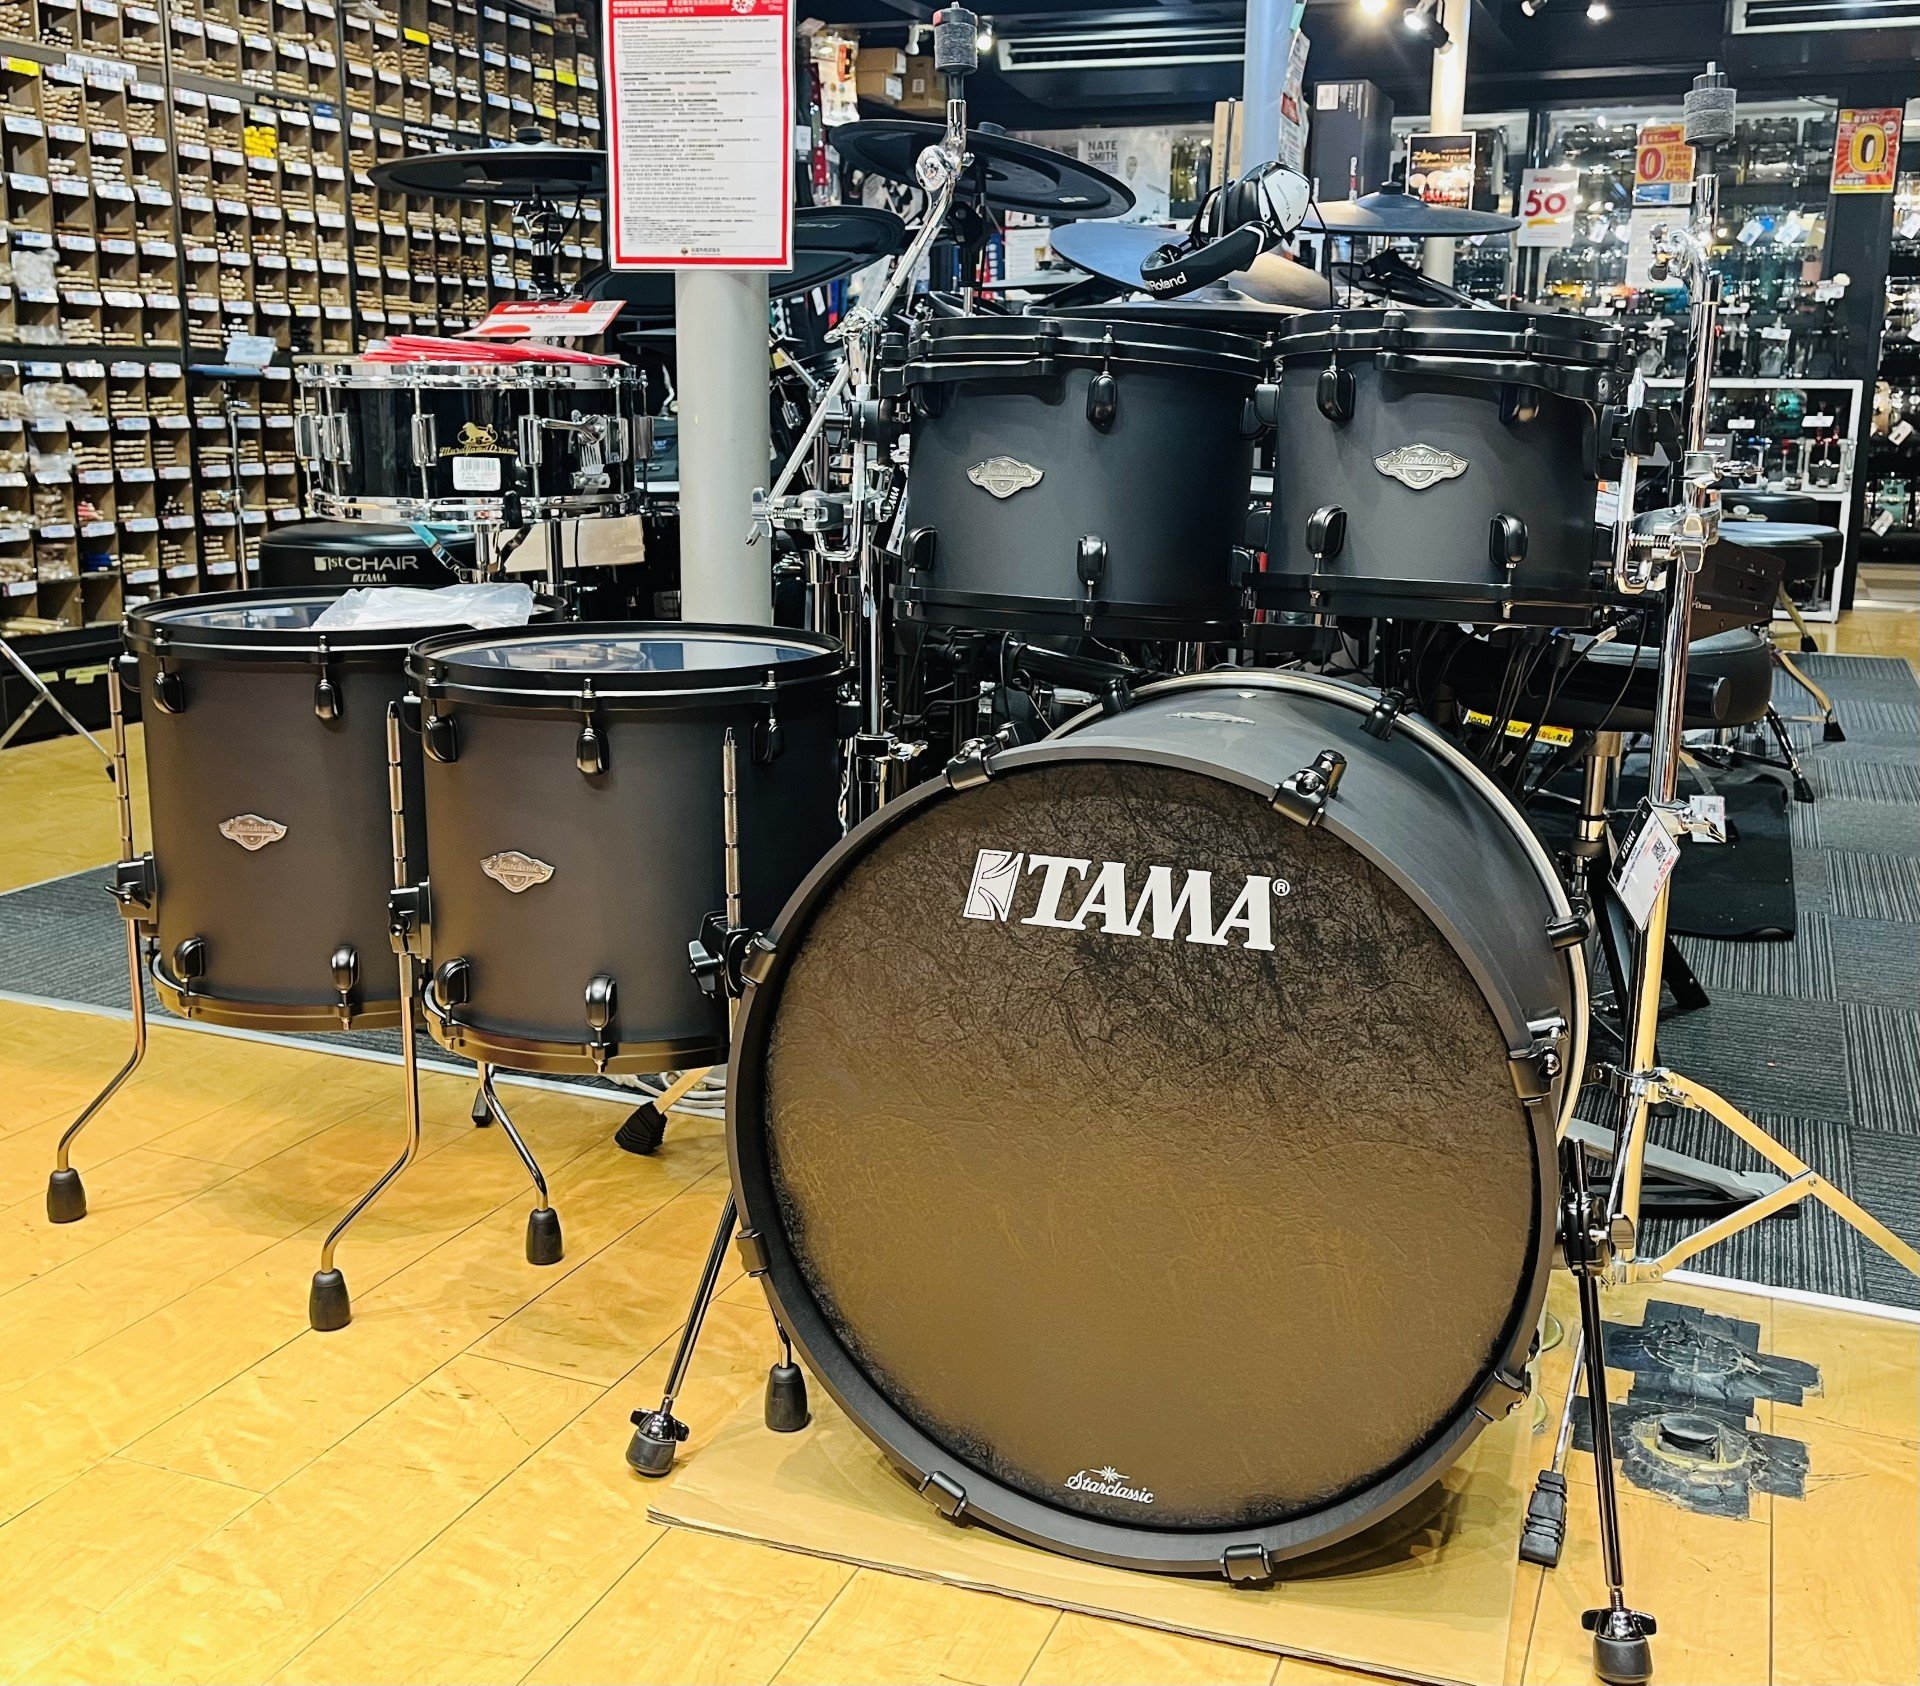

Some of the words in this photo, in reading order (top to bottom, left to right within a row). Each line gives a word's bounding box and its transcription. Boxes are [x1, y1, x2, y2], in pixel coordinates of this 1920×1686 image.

[1087, 140, 1118, 151] NATE
[1087, 151, 1118, 162] SMITH
[1524, 190, 1566, 217] 50
[1149, 271, 1187, 291] Roland
[1393, 451, 1450, 466] Starclassic
[344, 555, 419, 571] CHAIR
[358, 573, 387, 583] TAMA
[1064, 1470, 1154, 1504] Starclassic
